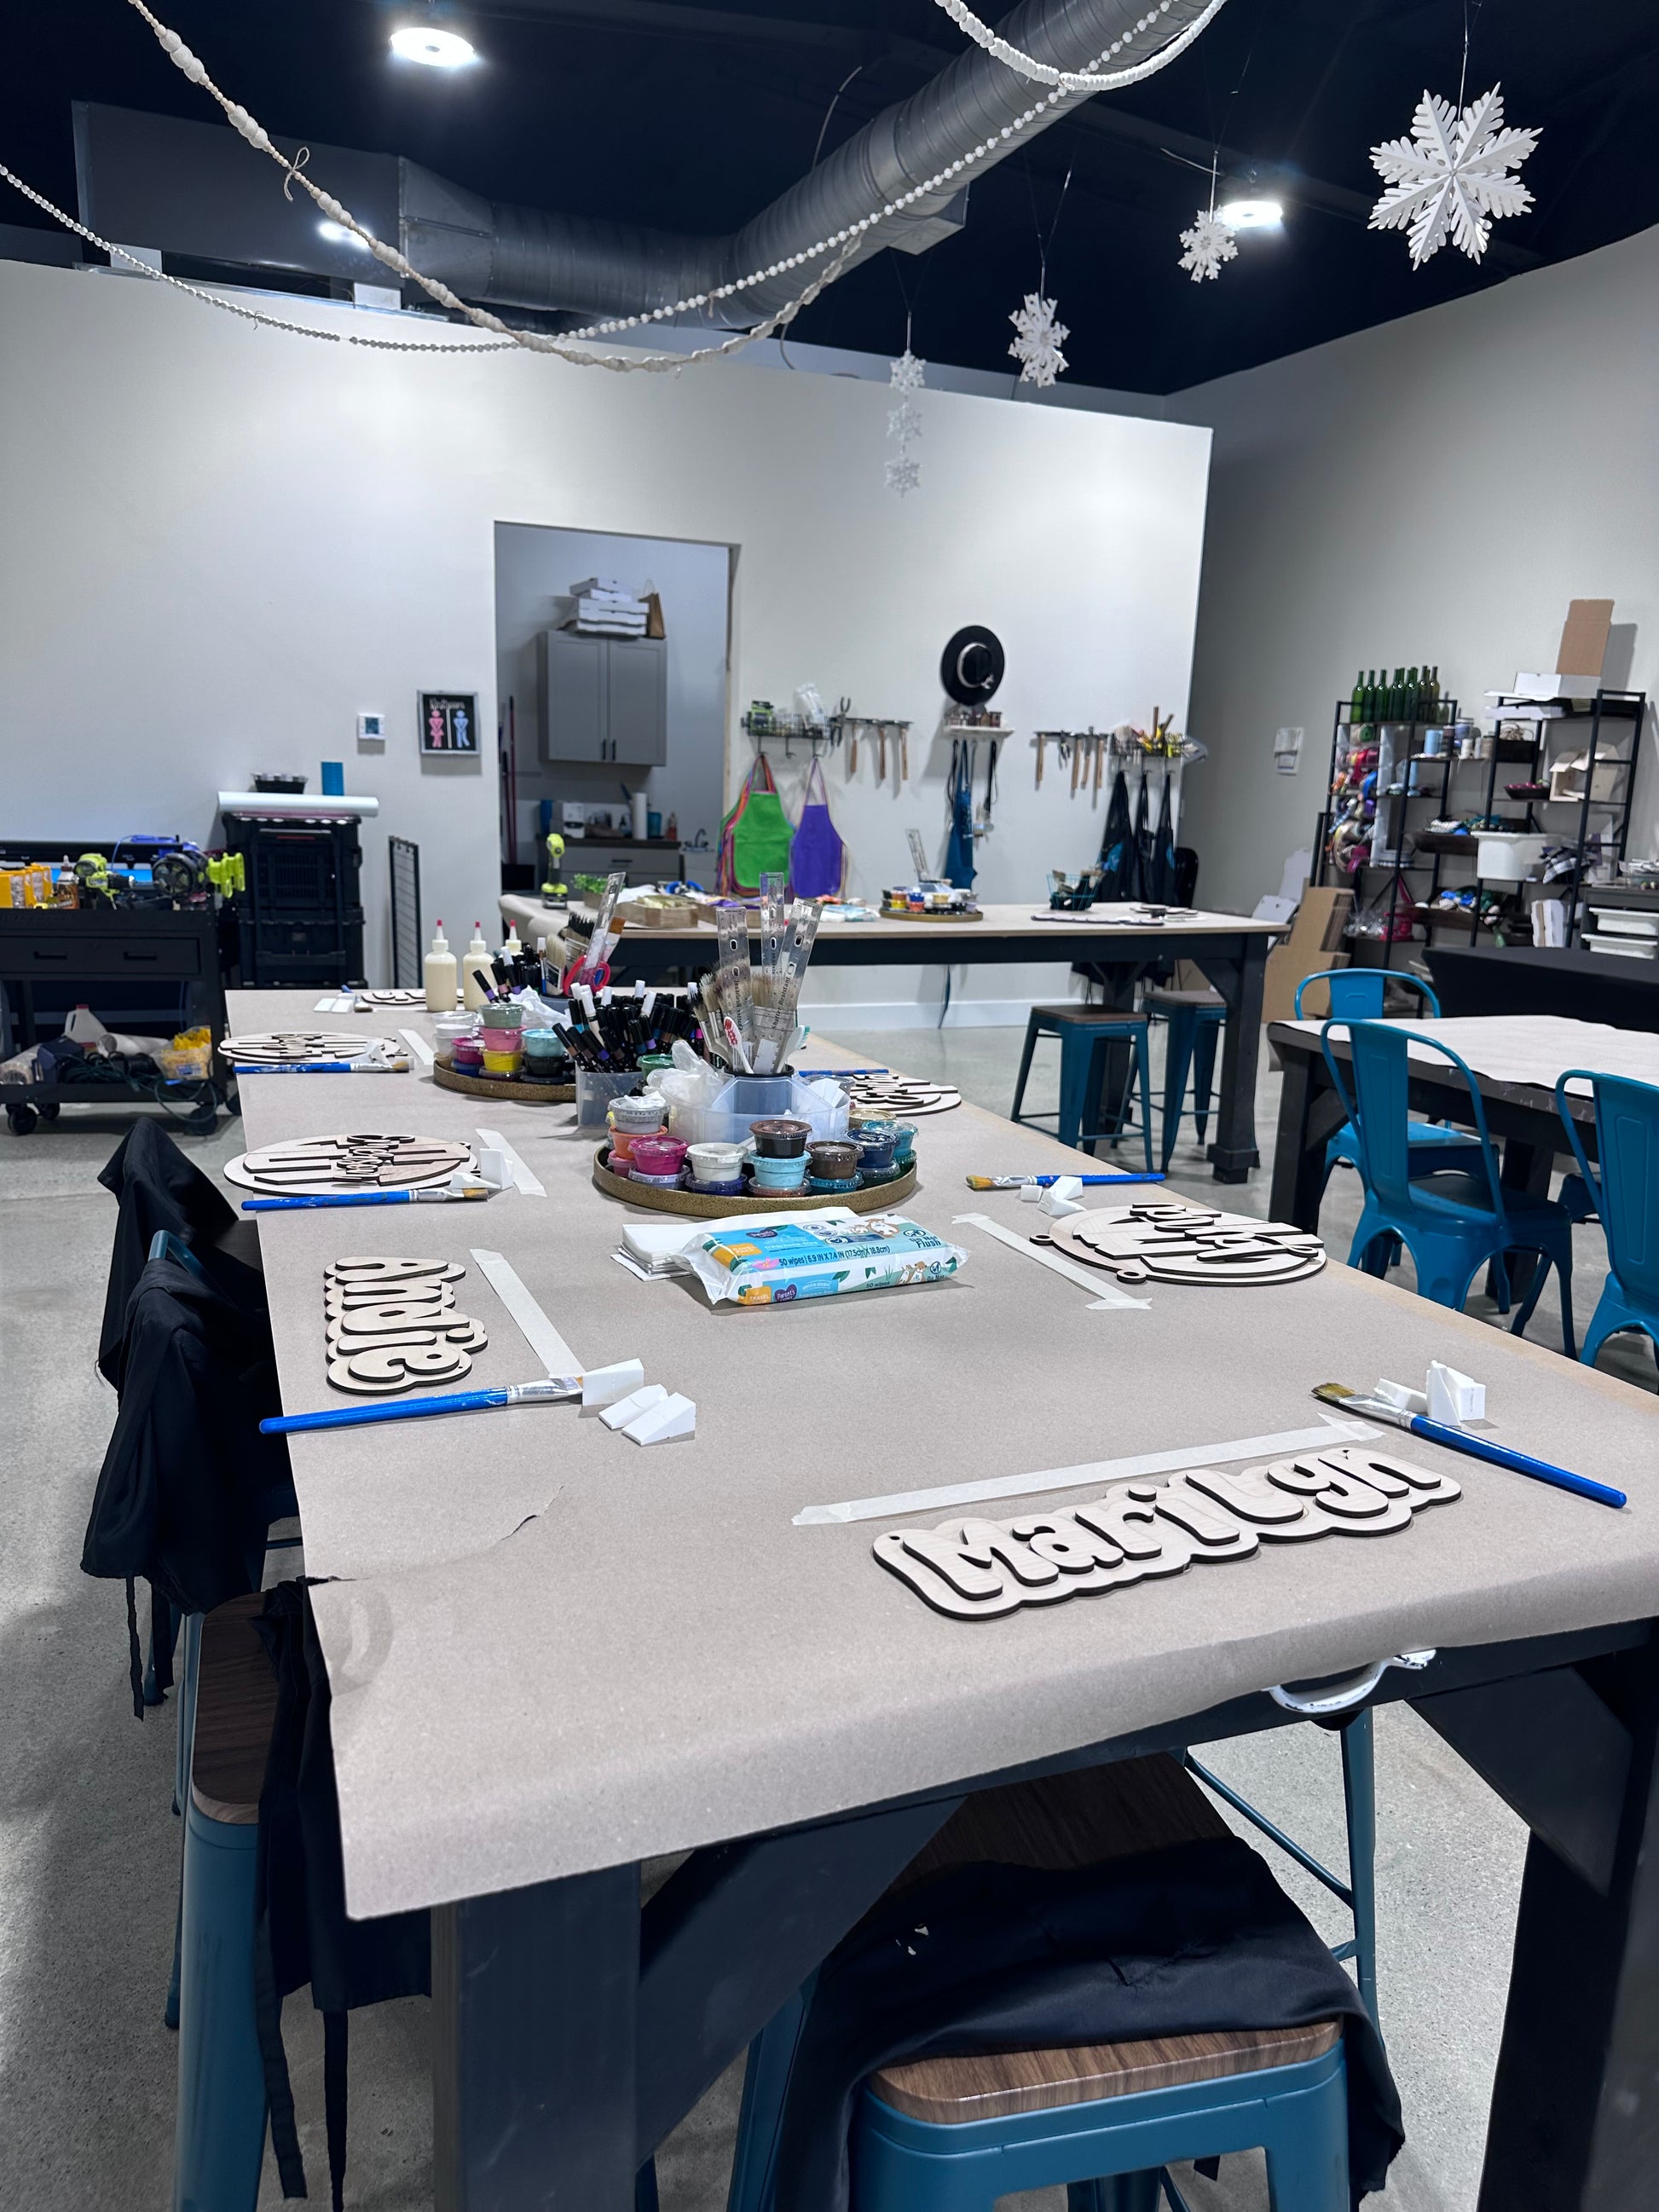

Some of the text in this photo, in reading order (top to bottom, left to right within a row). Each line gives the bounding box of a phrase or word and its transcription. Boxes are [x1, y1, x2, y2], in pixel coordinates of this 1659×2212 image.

[771, 977, 790, 1030] Shatter Resistant
[778, 1257, 788, 1267] 50
[789, 1256, 805, 1266] wipes
[808, 1255, 817, 1263] 6.9
[818, 1253, 824, 1262] IN
[838, 1250, 845, 1259] IN
[916, 1239, 941, 1248] Flush
[335, 1256, 474, 1383] Andie
